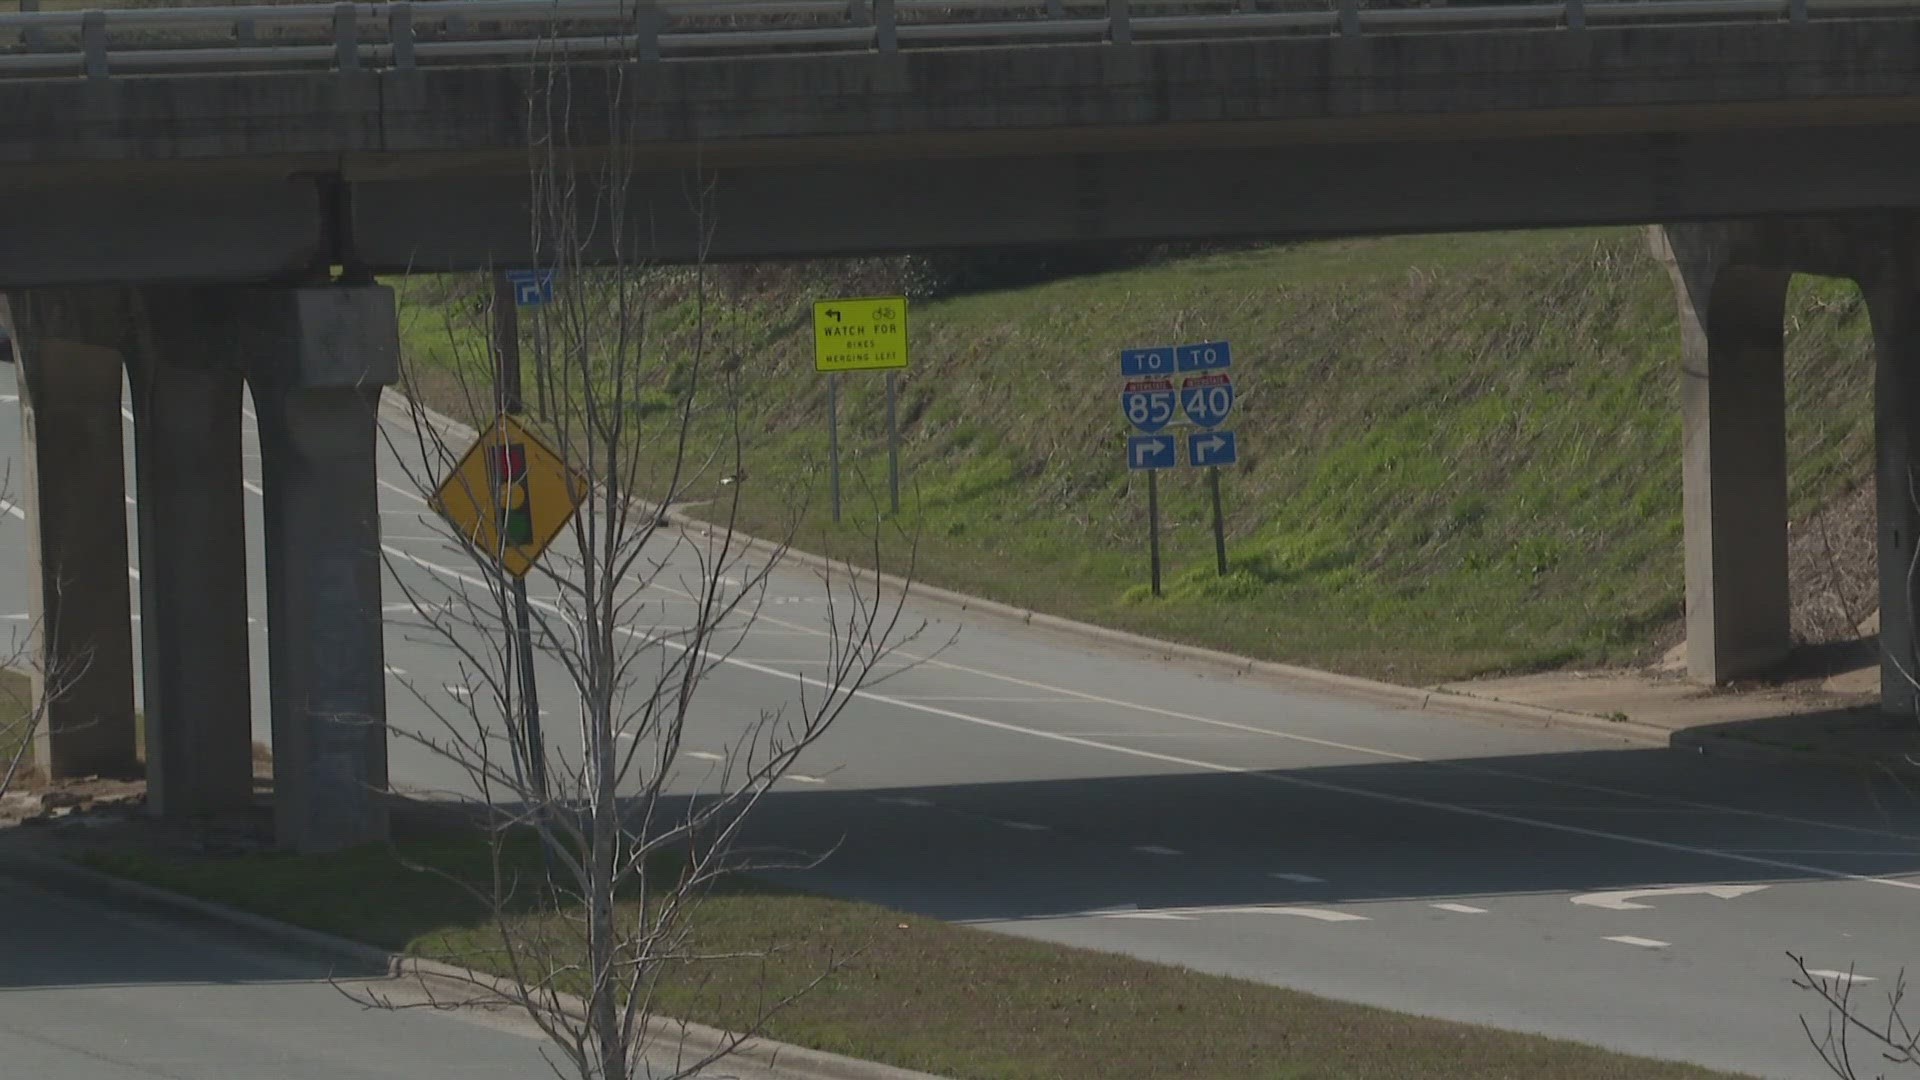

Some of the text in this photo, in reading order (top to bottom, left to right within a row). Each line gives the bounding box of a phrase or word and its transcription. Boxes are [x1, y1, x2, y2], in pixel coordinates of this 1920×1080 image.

[824, 324, 896, 336] WATCH FOR
[826, 353, 869, 362] MERGING
[1135, 353, 1161, 370] TO
[1191, 348, 1216, 365] TO
[1129, 393, 1169, 423] 85
[1187, 386, 1229, 418] 40
